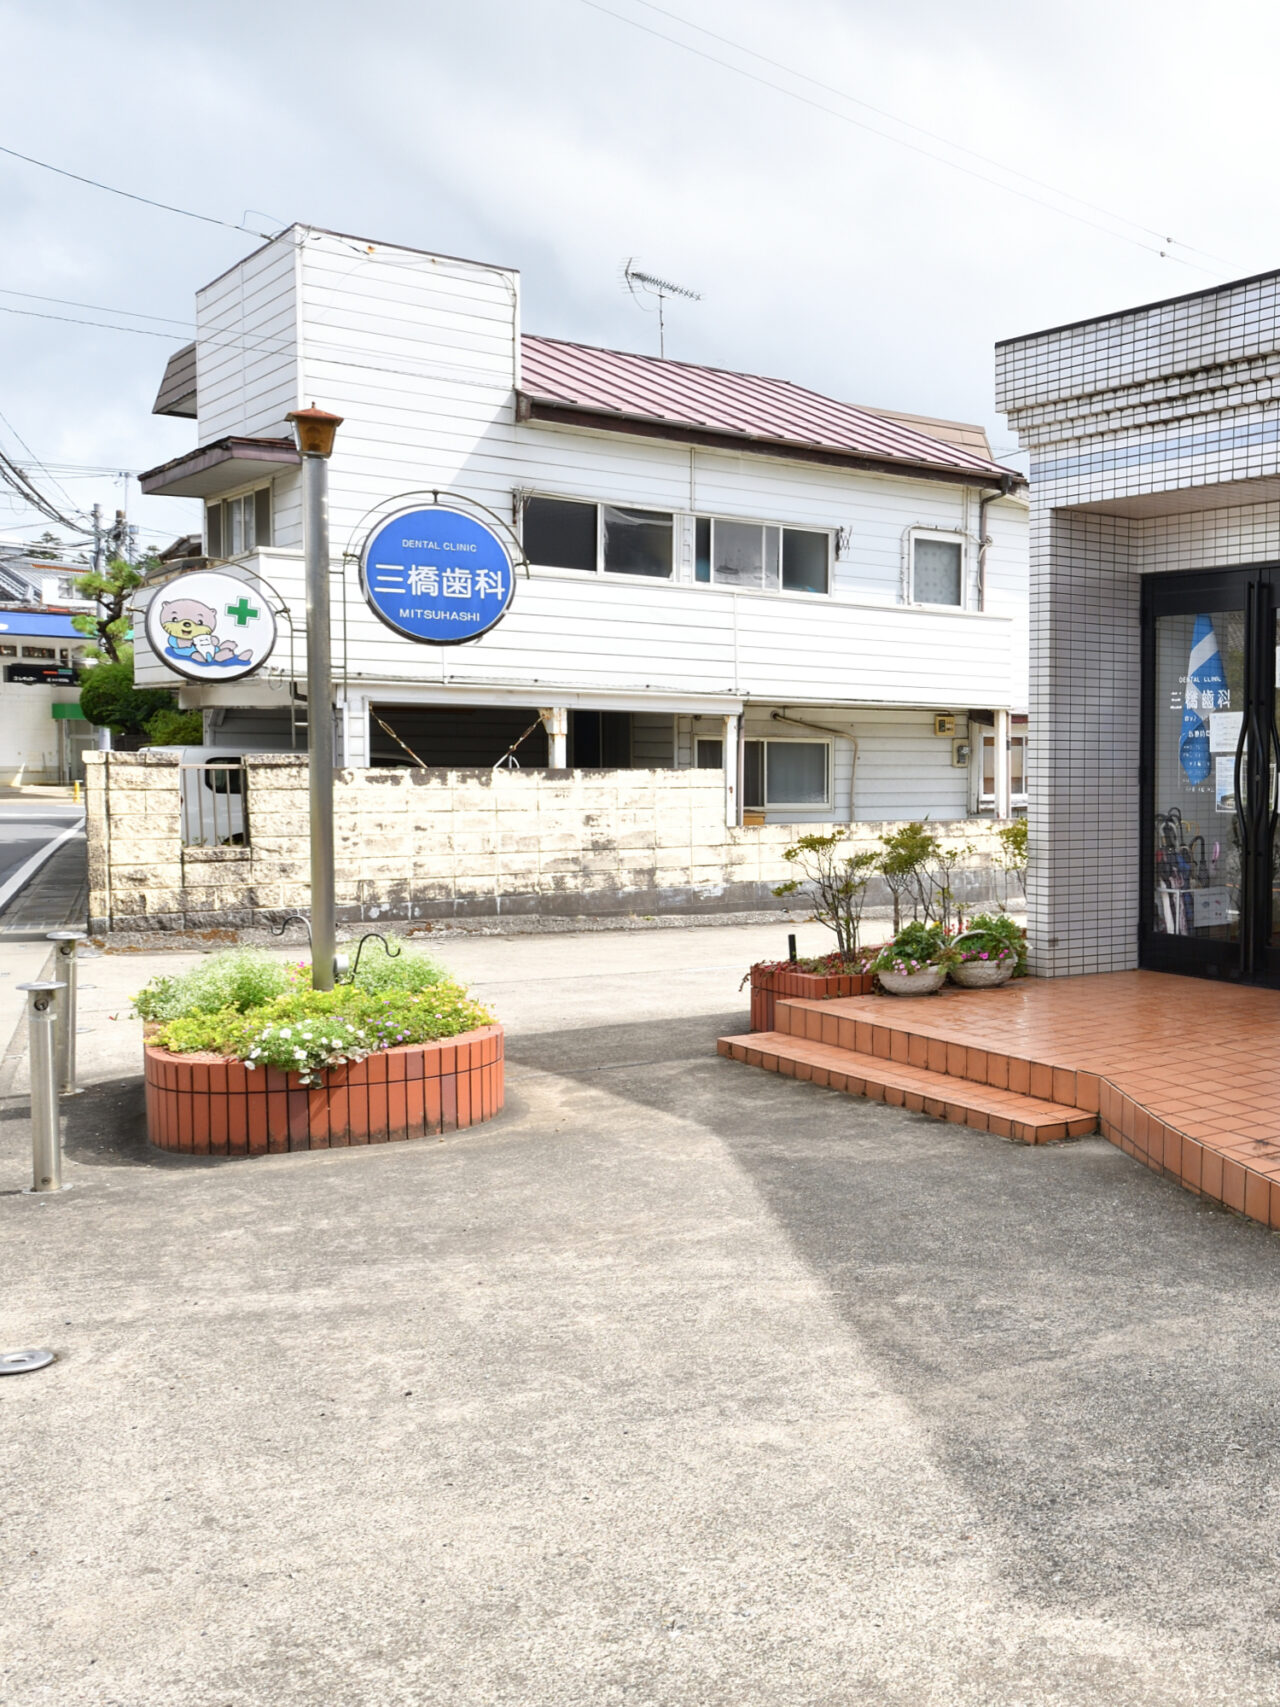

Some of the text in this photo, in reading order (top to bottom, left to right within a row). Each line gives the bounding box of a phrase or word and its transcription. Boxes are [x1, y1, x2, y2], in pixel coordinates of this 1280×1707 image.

[402, 539, 477, 552] DENTAL CLINIC
[374, 563, 505, 600] 三橋歯科
[400, 608, 480, 622] MITSUHASHI
